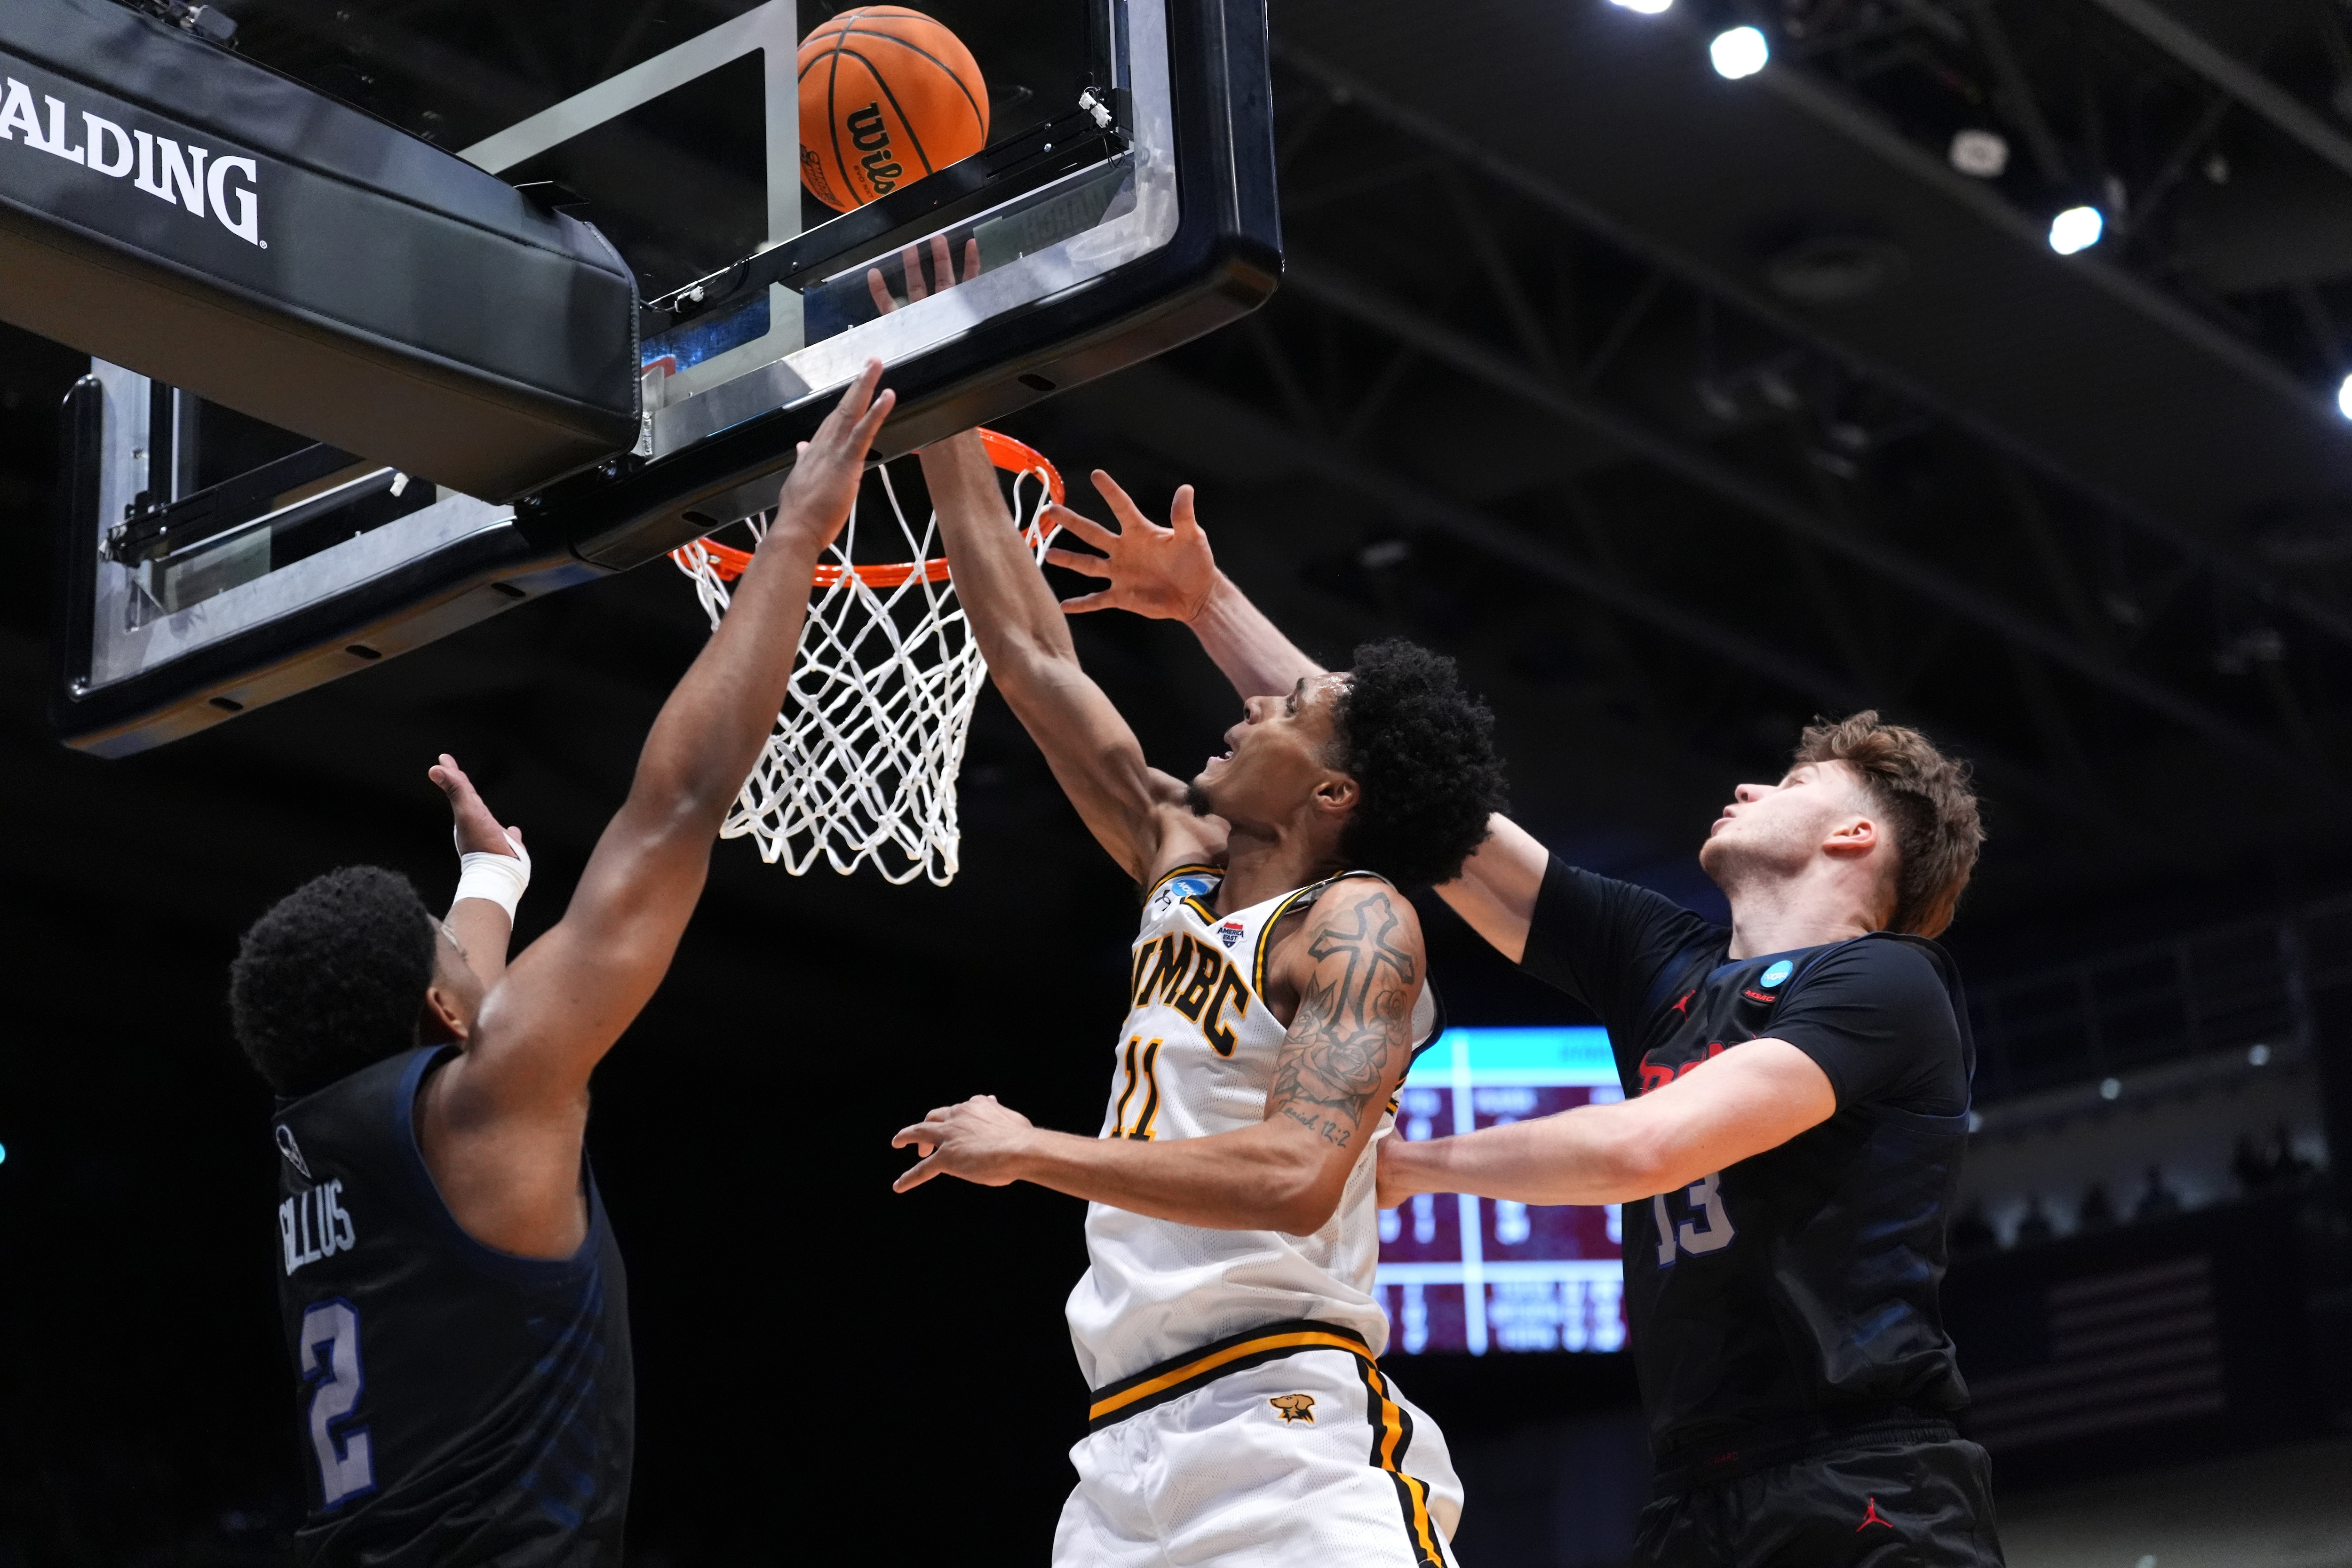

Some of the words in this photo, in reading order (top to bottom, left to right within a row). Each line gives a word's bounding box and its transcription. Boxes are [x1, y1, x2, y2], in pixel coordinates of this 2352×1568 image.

[0, 77, 258, 246] ALDING
[1217, 927, 1244, 938] AMERICA
[1110, 1035, 1164, 1142] 11
[1321, 1120, 1351, 1148] 12:2
[1654, 1171, 1738, 1269] 13
[301, 1296, 376, 1512] 2
